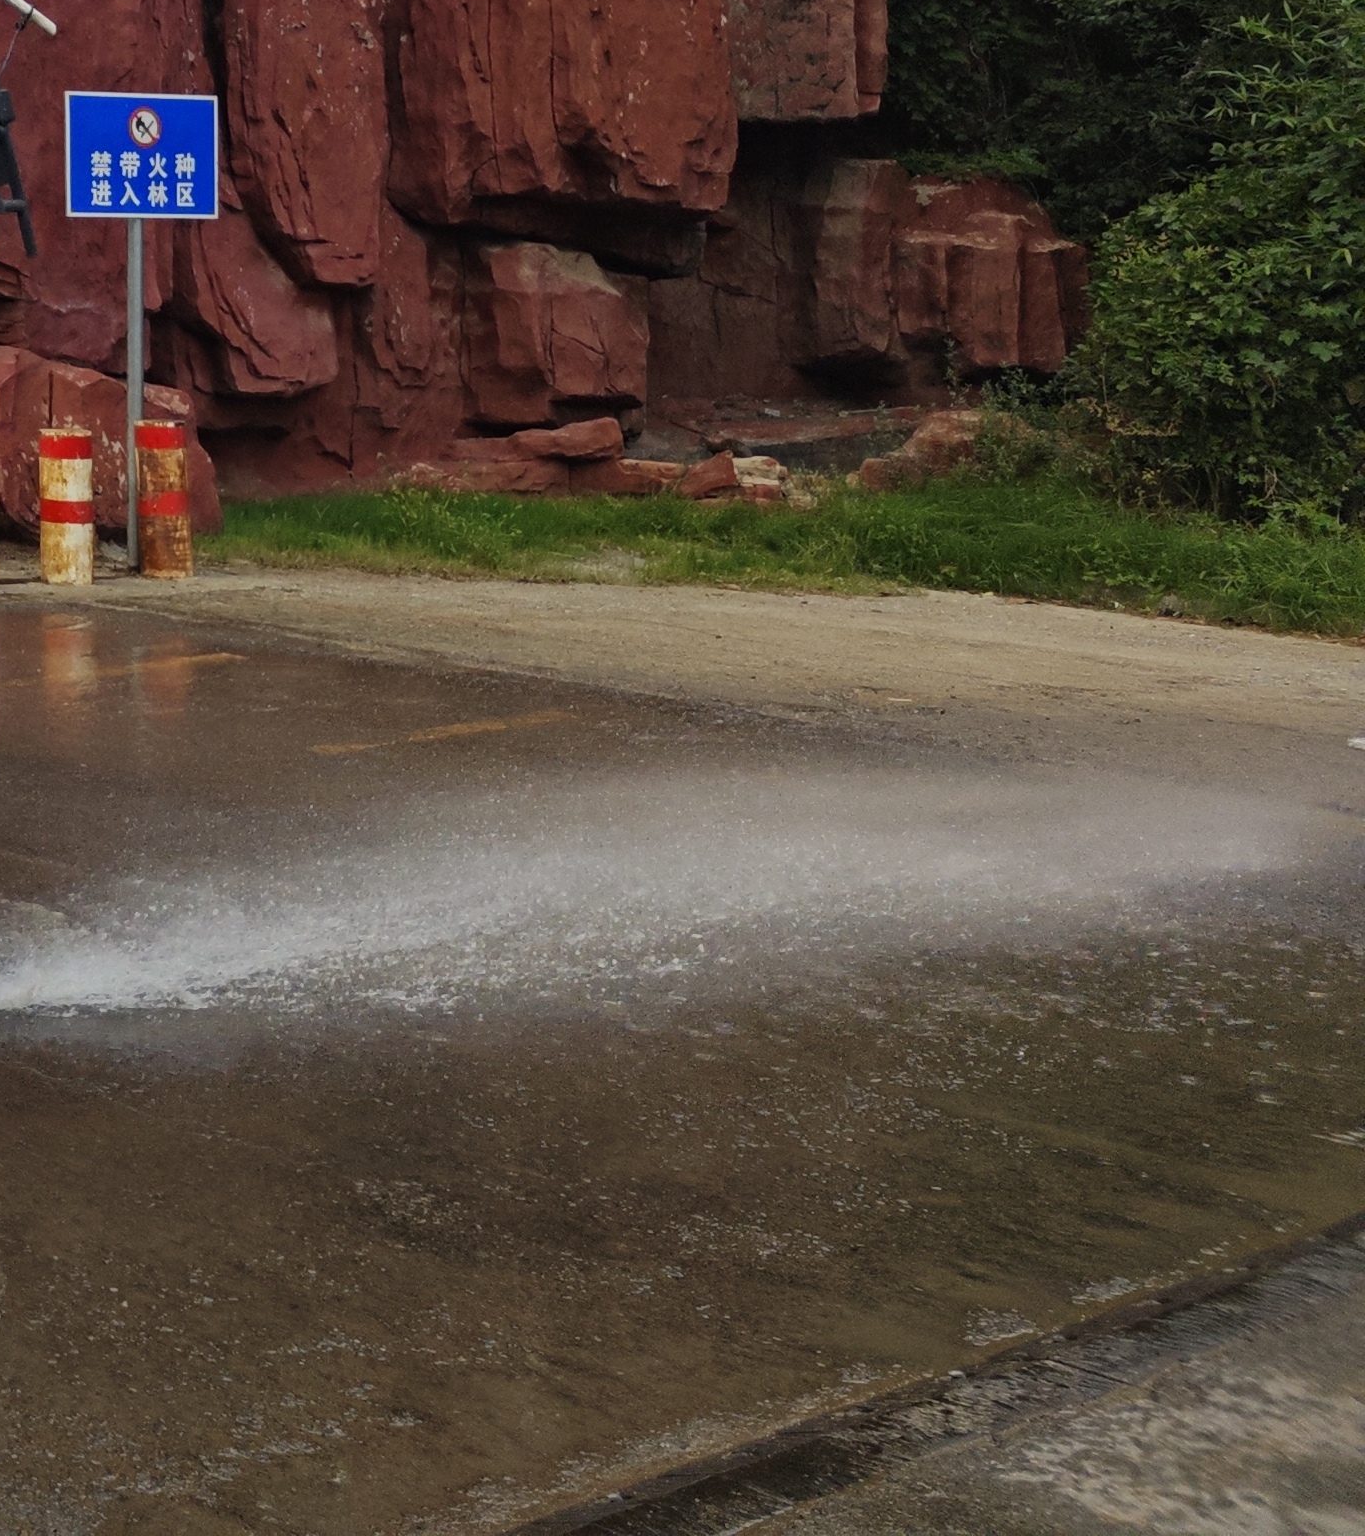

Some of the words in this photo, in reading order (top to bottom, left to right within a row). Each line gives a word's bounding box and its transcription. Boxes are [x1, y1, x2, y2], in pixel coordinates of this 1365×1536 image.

[90, 150, 196, 179] 禁带火种
[90, 179, 196, 208] 进入林区
